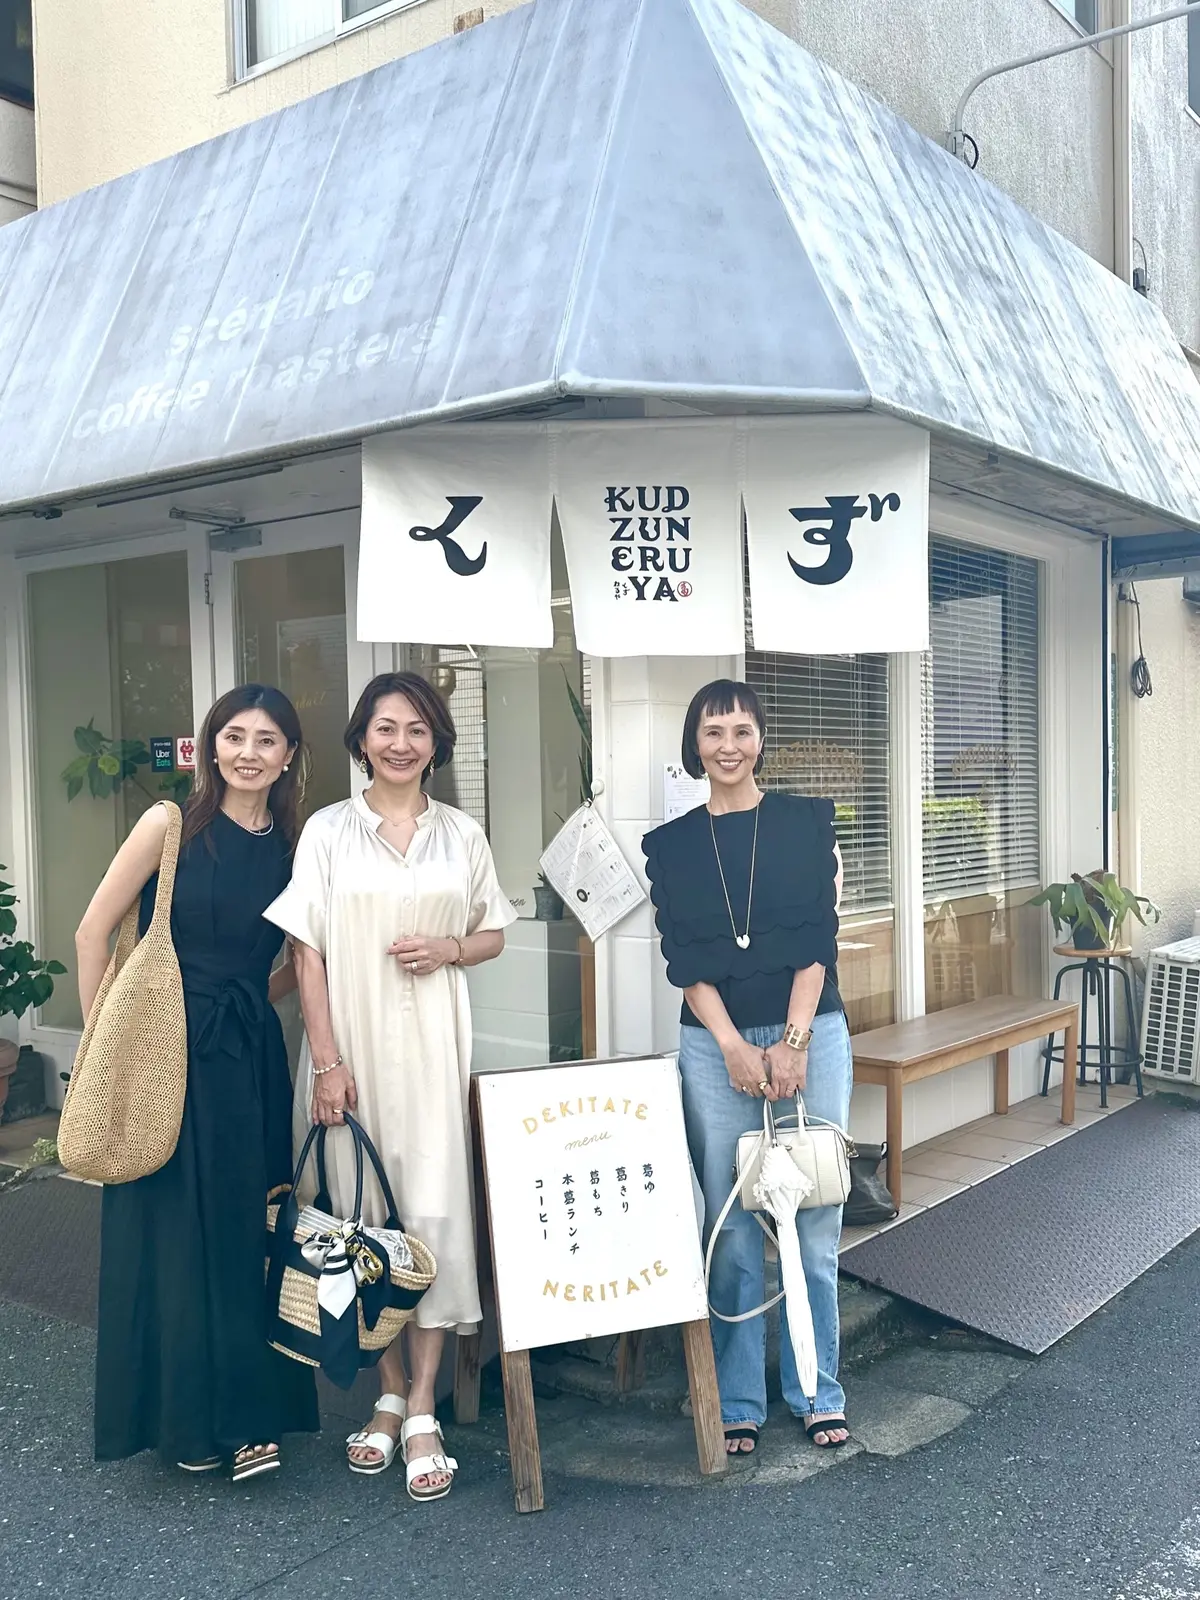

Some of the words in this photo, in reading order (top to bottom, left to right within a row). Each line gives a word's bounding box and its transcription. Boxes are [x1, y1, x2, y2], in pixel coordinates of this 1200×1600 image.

[170, 267, 374, 355] scénario
[76, 378, 208, 437] coffee
[226, 313, 446, 393] roasters
[604, 486, 690, 512] KUD
[409, 496, 487, 576] く
[787, 493, 900, 586] ず
[609, 517, 691, 541] ZUN
[611, 546, 692, 573] ERU
[627, 576, 679, 602] YA
[155, 749, 170, 758] Uber
[156, 758, 171, 767] Eats
[522, 1096, 648, 1134] DEKITATE
[564, 1131, 612, 1150] menu
[589, 1169, 602, 1216] 葛もち
[615, 1166, 629, 1213] 葛きり
[643, 1163, 655, 1193] 葛ゆ
[535, 1179, 548, 1240] コーヒー
[562, 1173, 580, 1255] 本葛ランチ
[543, 1260, 668, 1303] NERITATE
